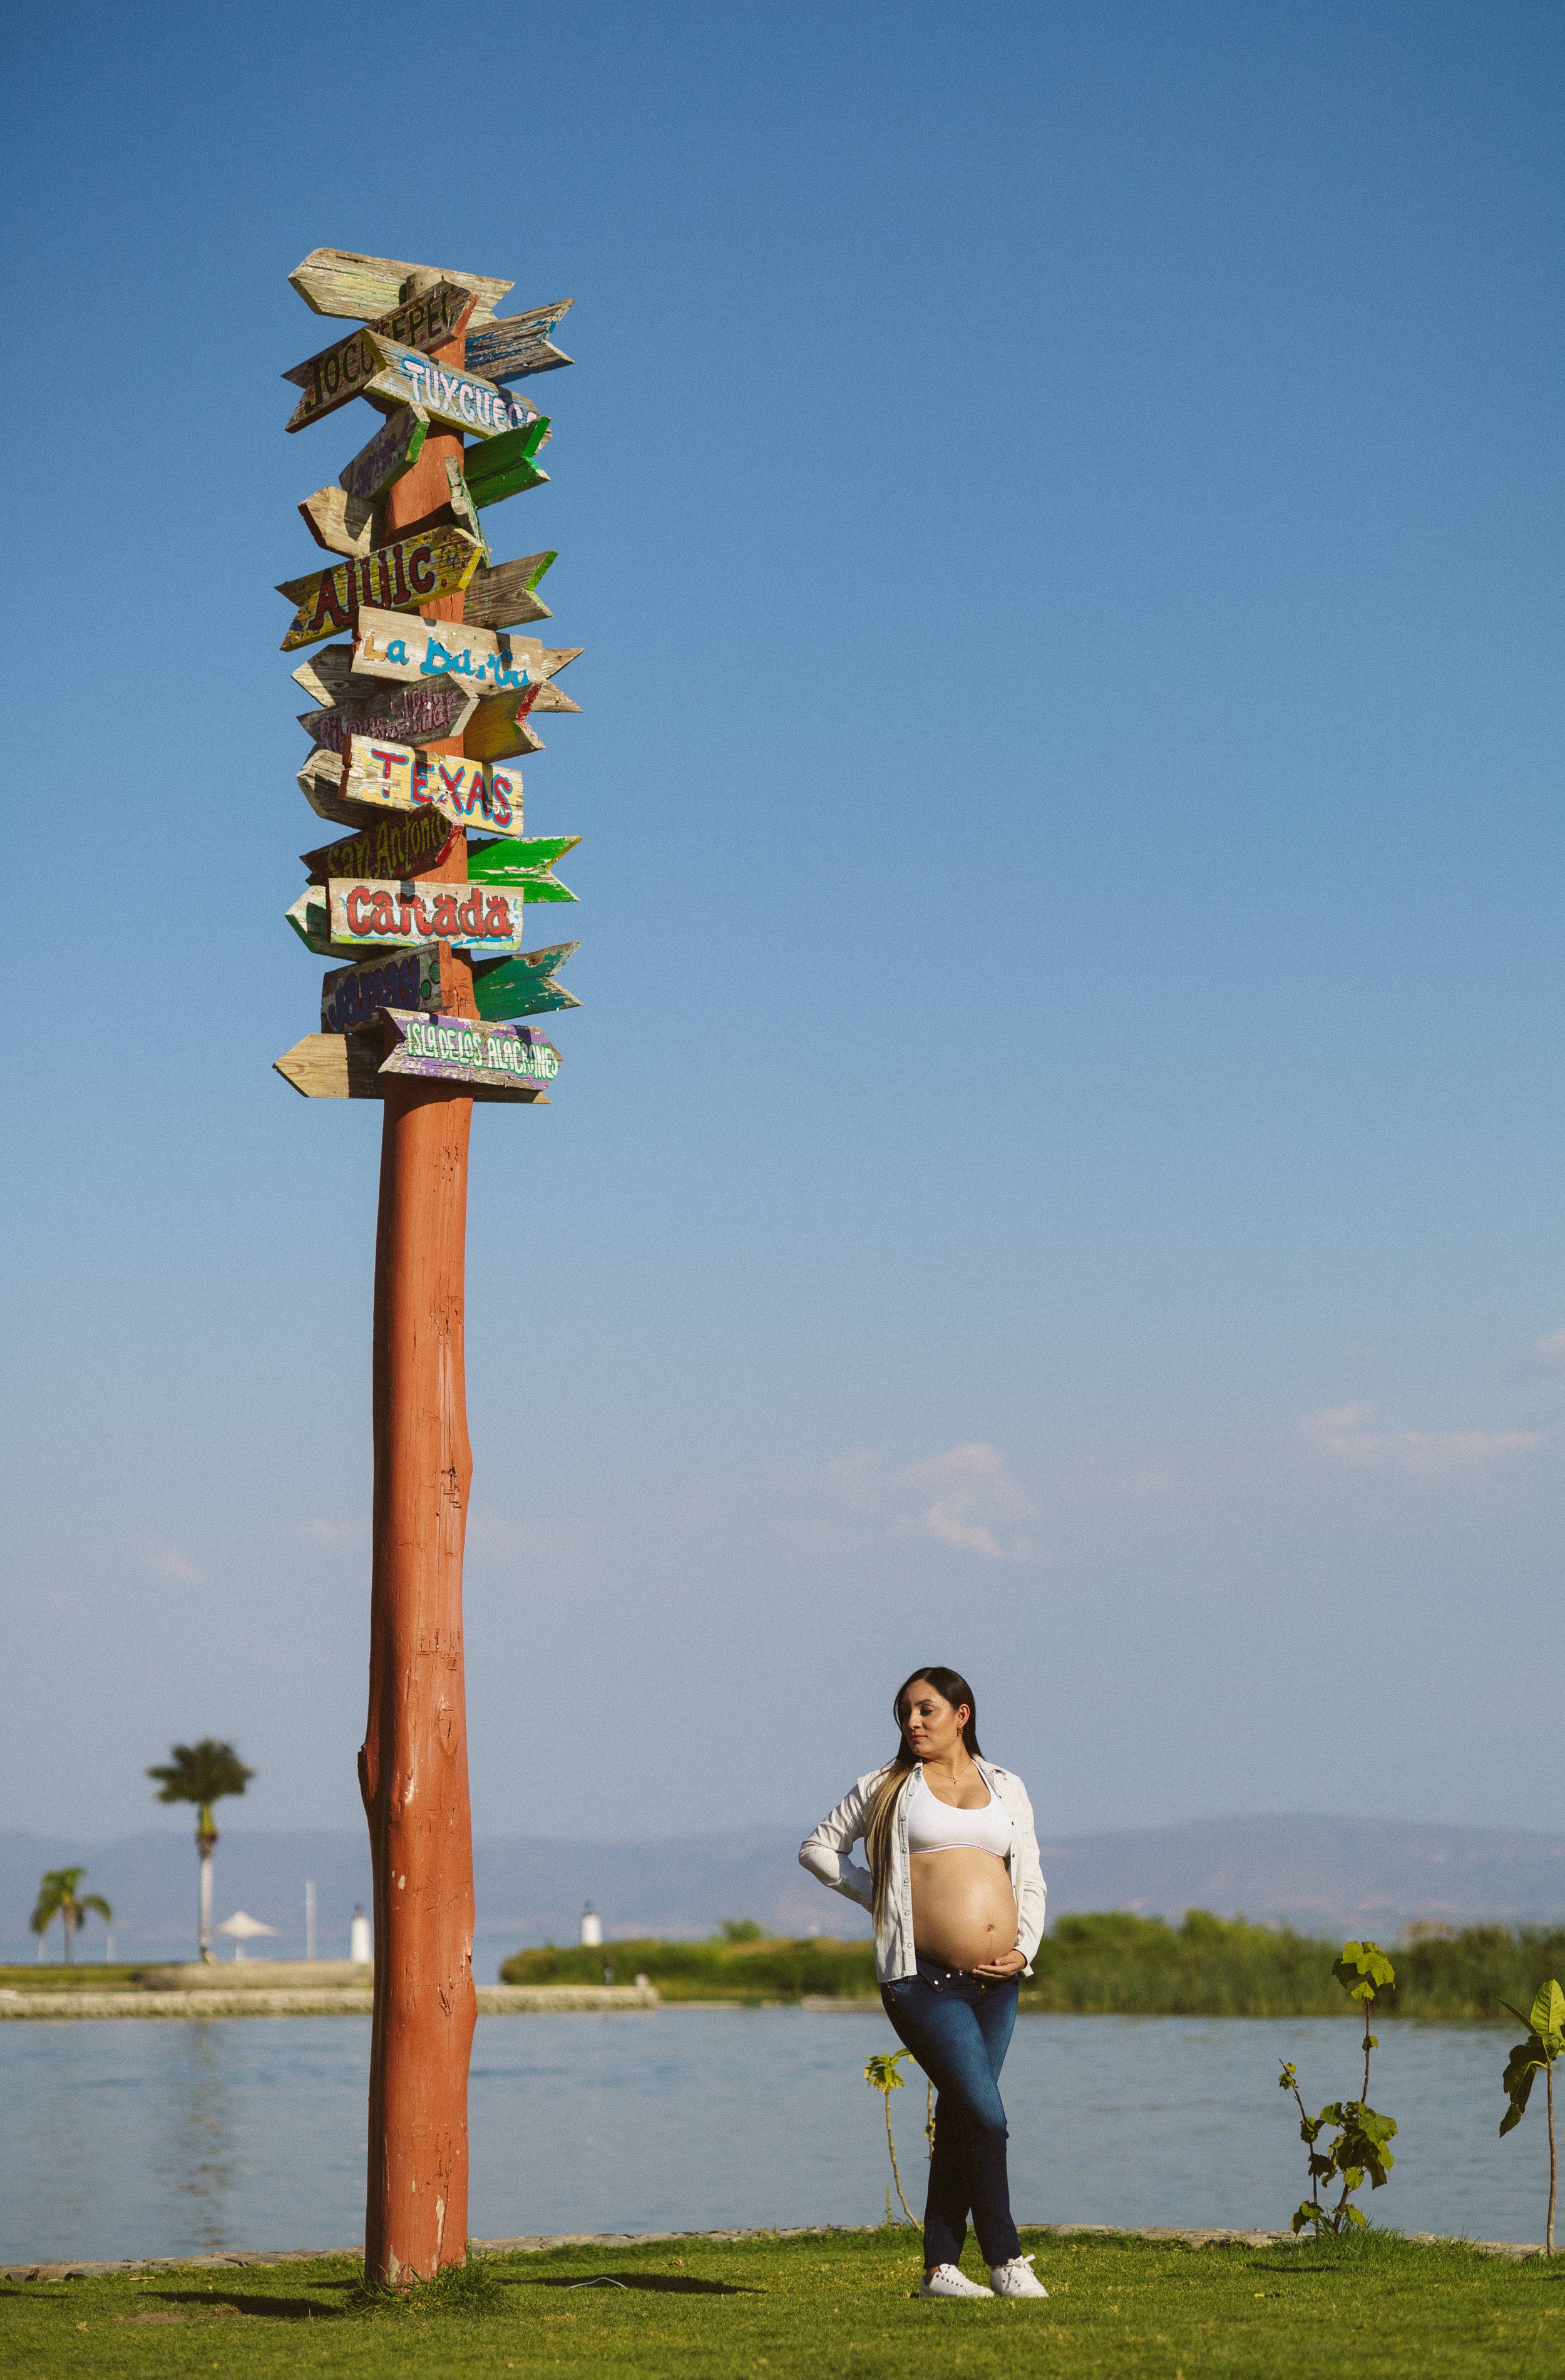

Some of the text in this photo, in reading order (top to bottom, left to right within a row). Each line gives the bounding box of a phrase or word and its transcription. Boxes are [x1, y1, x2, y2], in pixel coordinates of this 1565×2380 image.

[363, 630, 410, 665] La
[370, 748, 513, 828] TEXAS
[373, 813, 450, 879] Antonio
[346, 885, 514, 937] Canada
